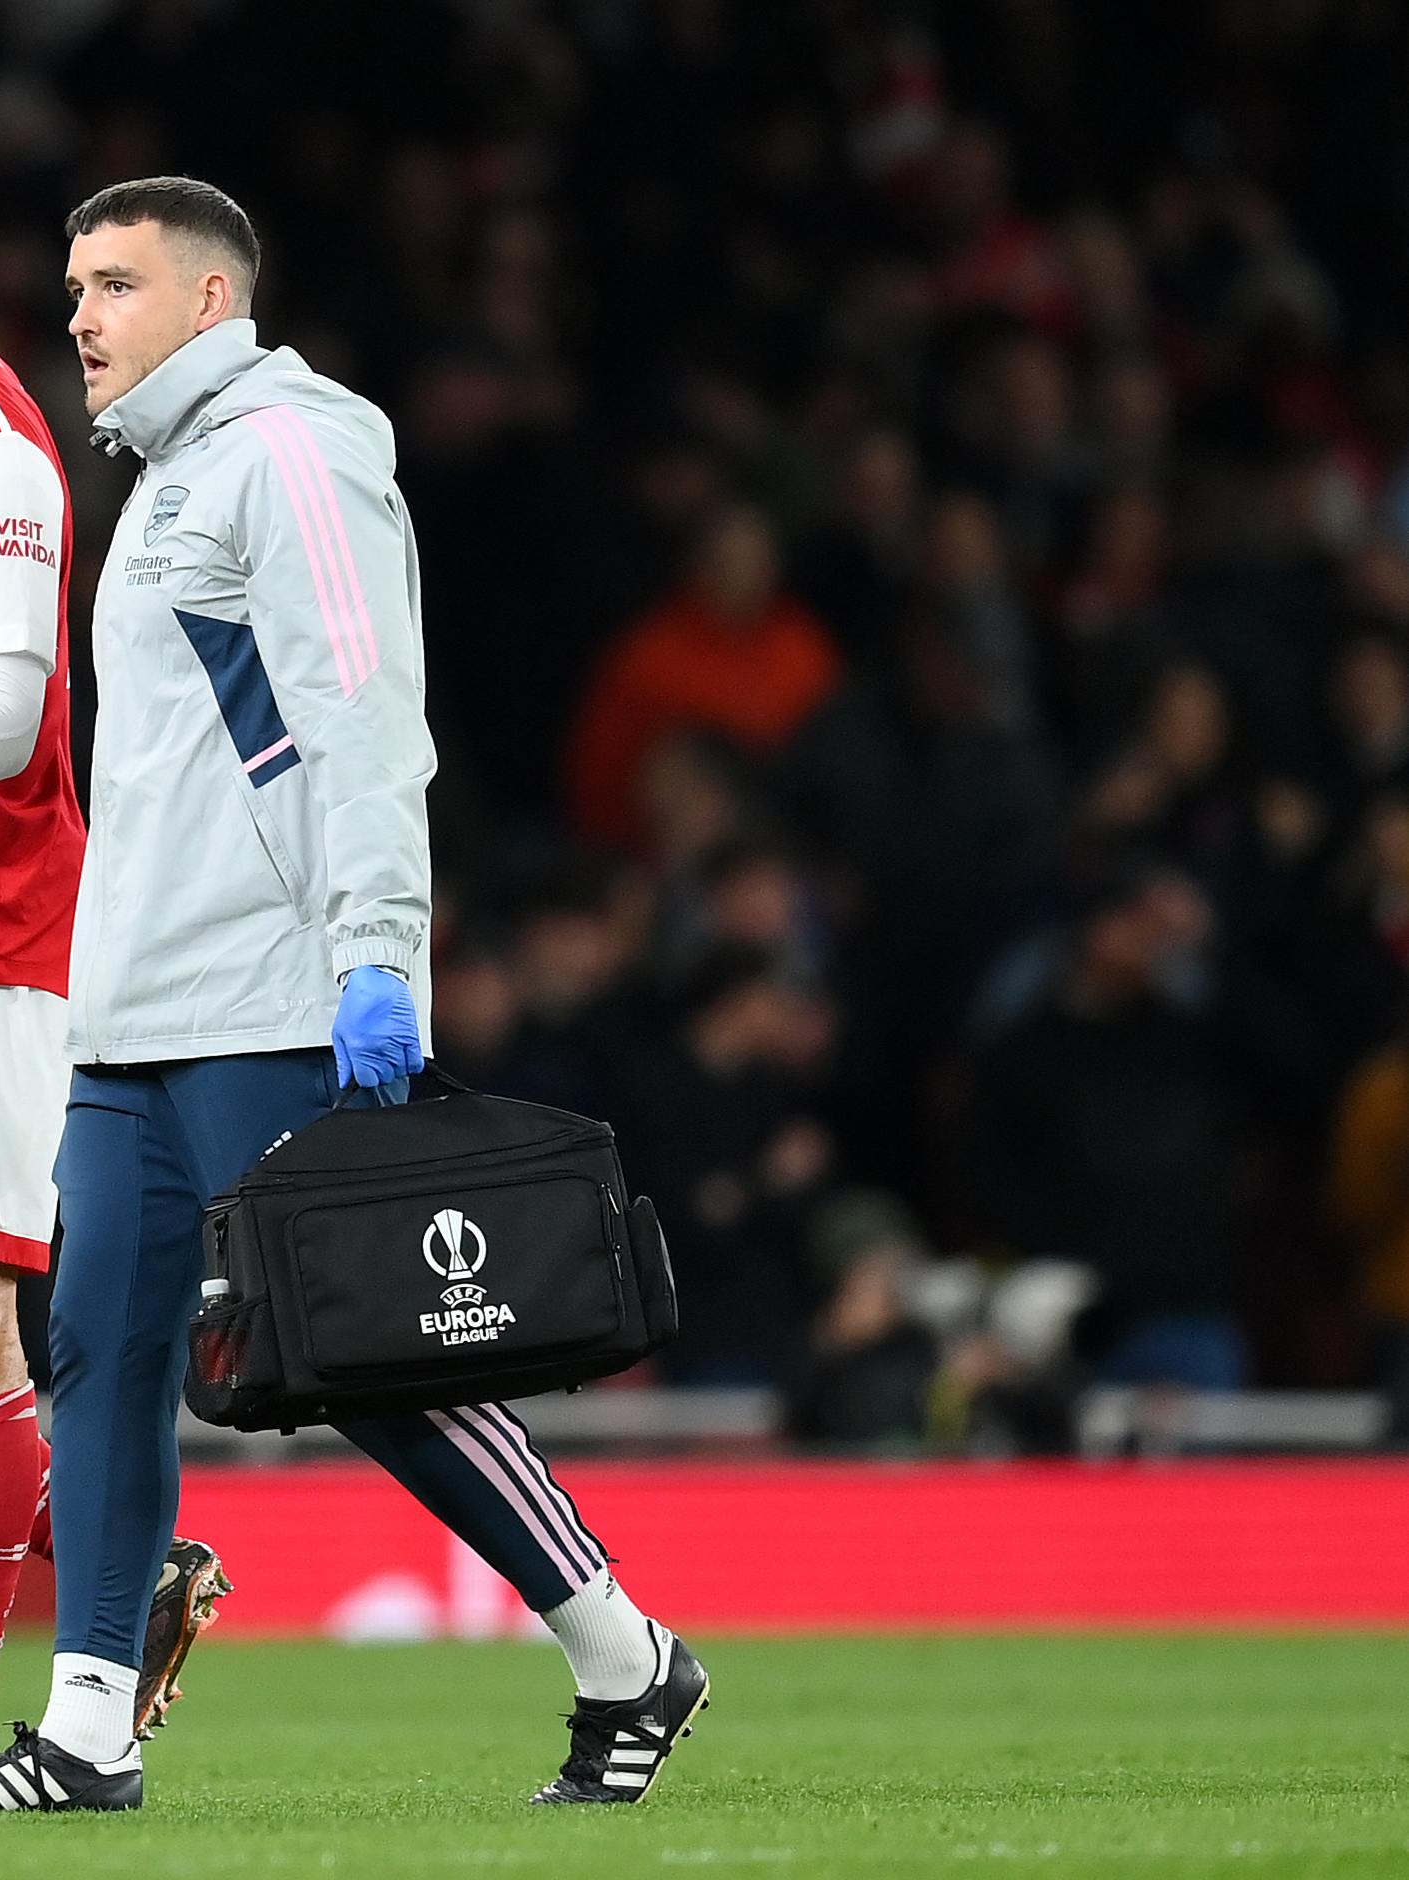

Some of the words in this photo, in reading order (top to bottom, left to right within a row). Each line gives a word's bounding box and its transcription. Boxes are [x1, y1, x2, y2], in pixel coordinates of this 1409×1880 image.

[124, 554, 174, 572] Emirates
[442, 1287, 484, 1306] UEFA
[419, 1303, 517, 1335] EUROPA
[64, 1679, 112, 1696] adidas
